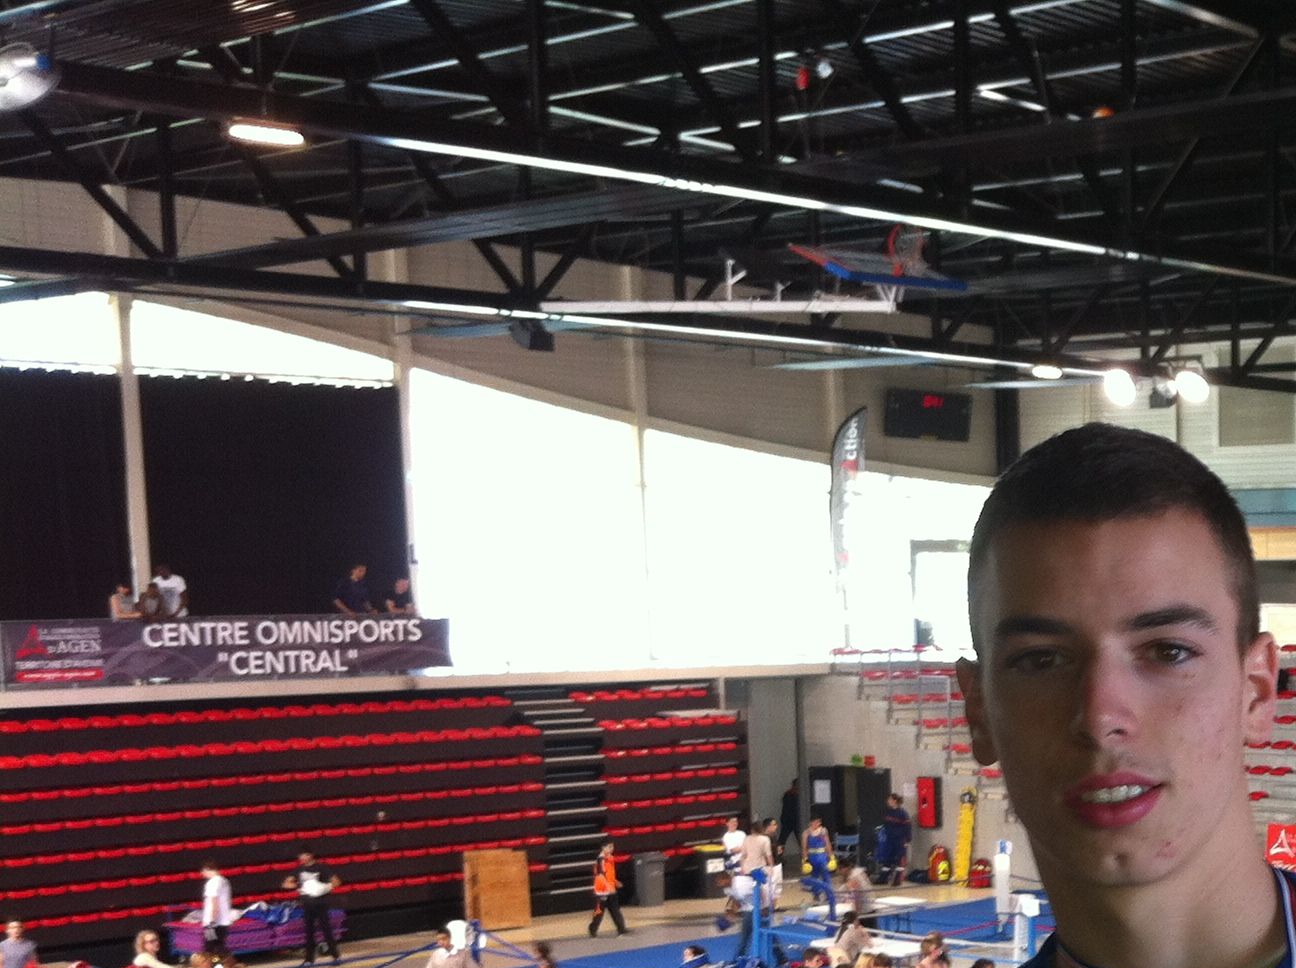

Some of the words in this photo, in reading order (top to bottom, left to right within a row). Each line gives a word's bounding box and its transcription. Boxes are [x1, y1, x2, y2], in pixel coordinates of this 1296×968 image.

[143, 621, 249, 648] CENTRE
[255, 618, 422, 645] OMNISPORTS
[218, 648, 358, 675] "CENTRAL"
